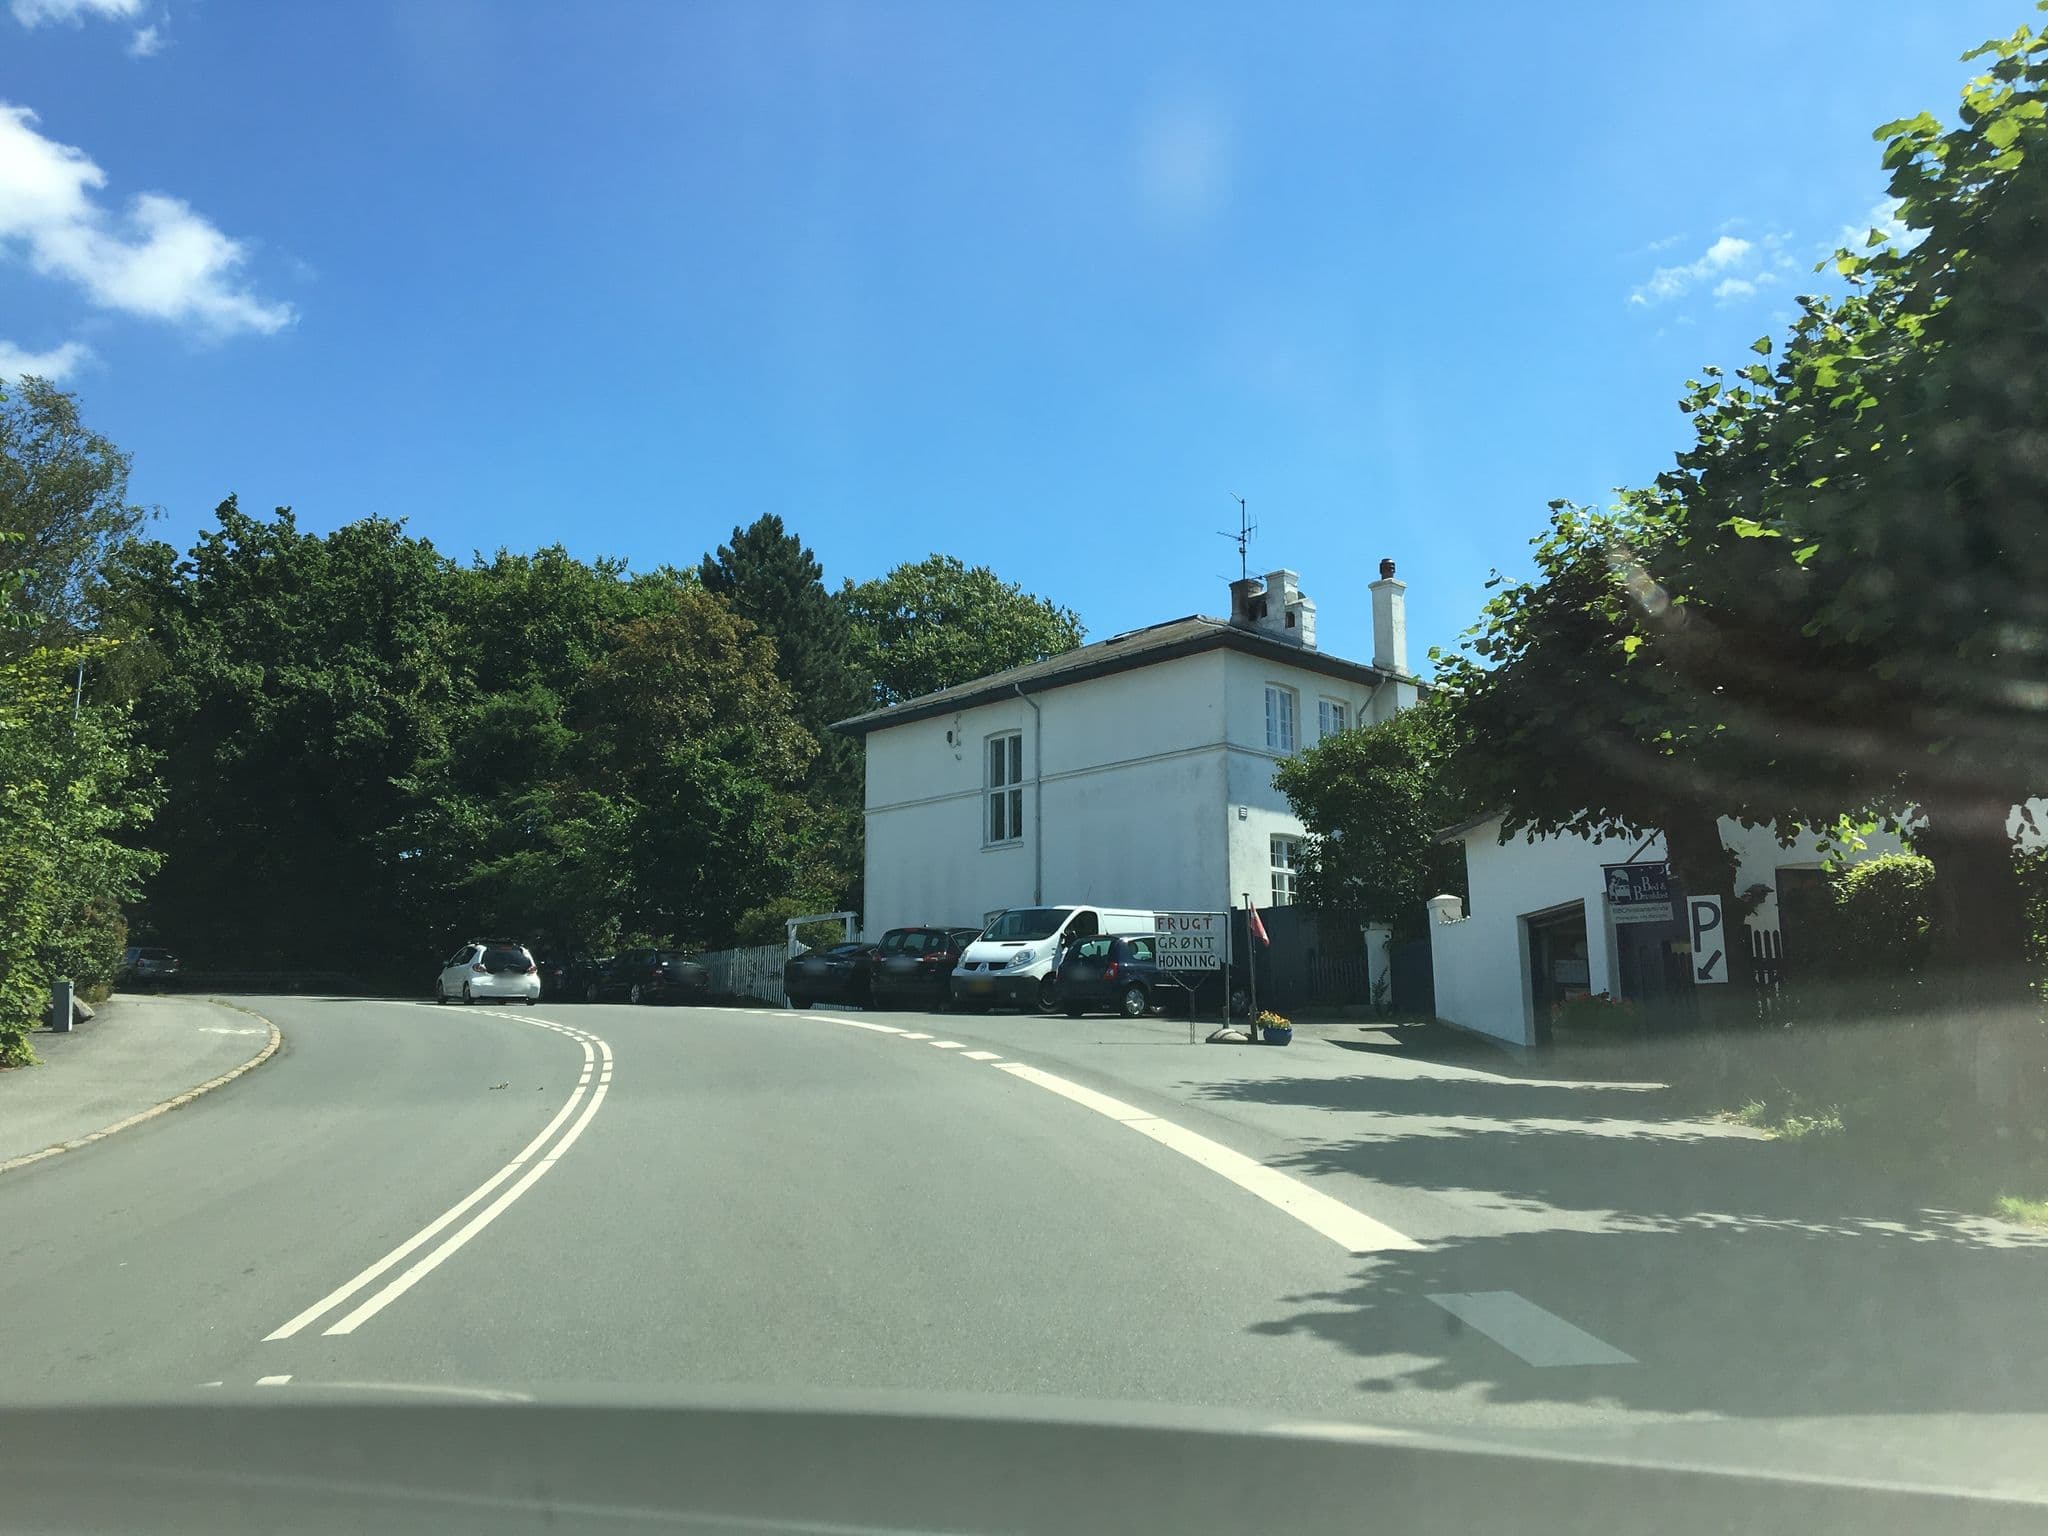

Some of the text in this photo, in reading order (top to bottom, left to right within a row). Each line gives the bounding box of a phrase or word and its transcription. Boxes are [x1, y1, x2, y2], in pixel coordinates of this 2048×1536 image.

[1633, 885, 1668, 900] Brkfast
[1157, 917, 1213, 930] FRUGT
[1691, 901, 1721, 953] P
[1158, 936, 1214, 949] GRØNT
[1158, 954, 1216, 967] HONNING
